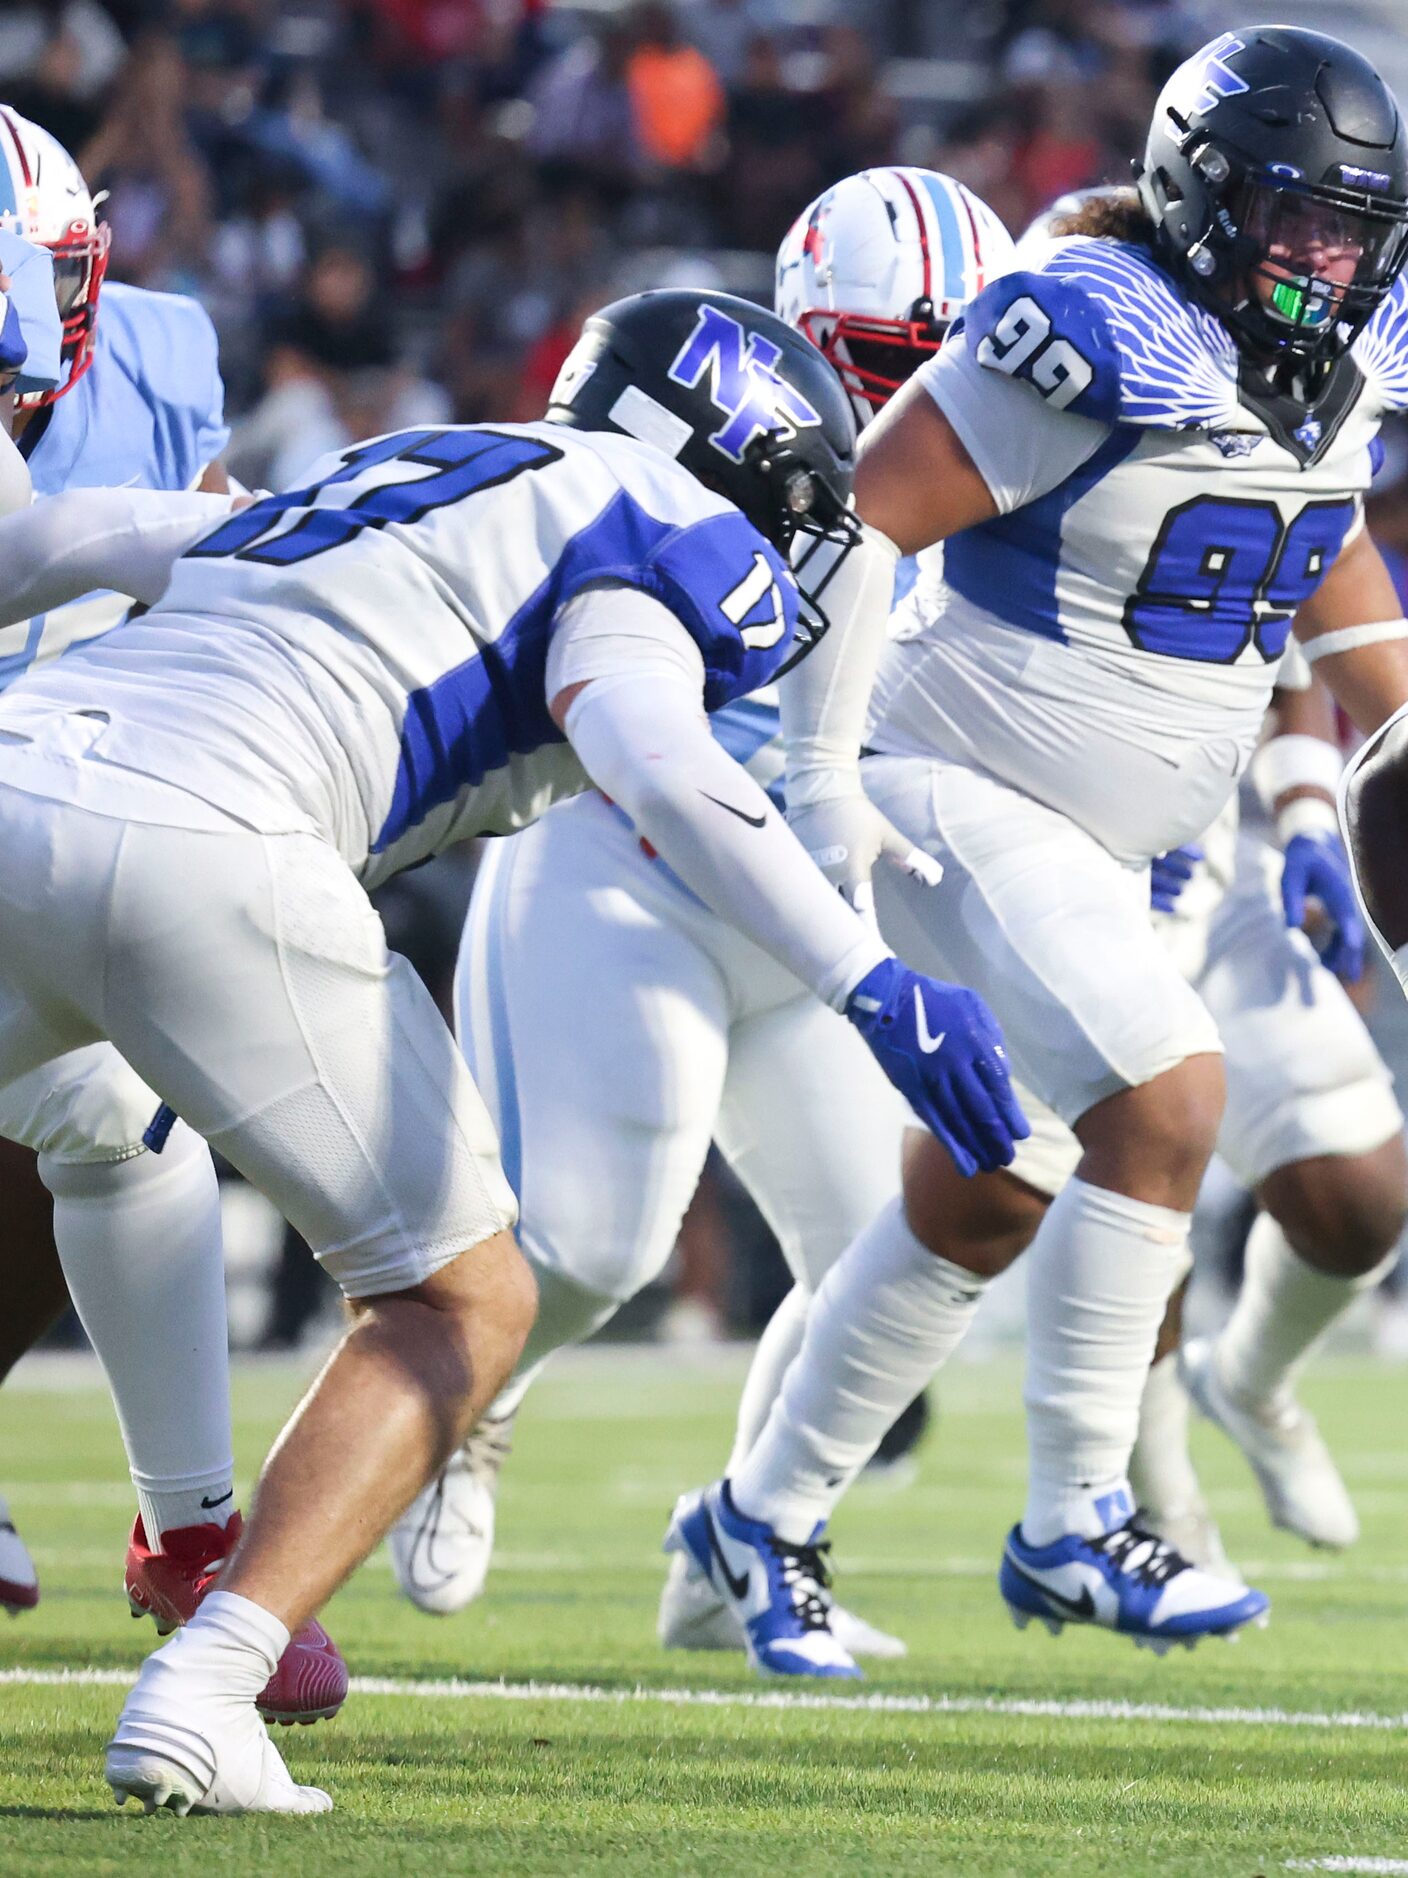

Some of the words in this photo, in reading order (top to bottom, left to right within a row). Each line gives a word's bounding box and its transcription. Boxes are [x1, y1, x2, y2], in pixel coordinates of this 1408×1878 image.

[667, 303, 823, 465] NF
[976, 296, 1092, 410] 99
[182, 430, 565, 567] 17
[718, 550, 787, 651] 17
[1120, 493, 1356, 665] 99
